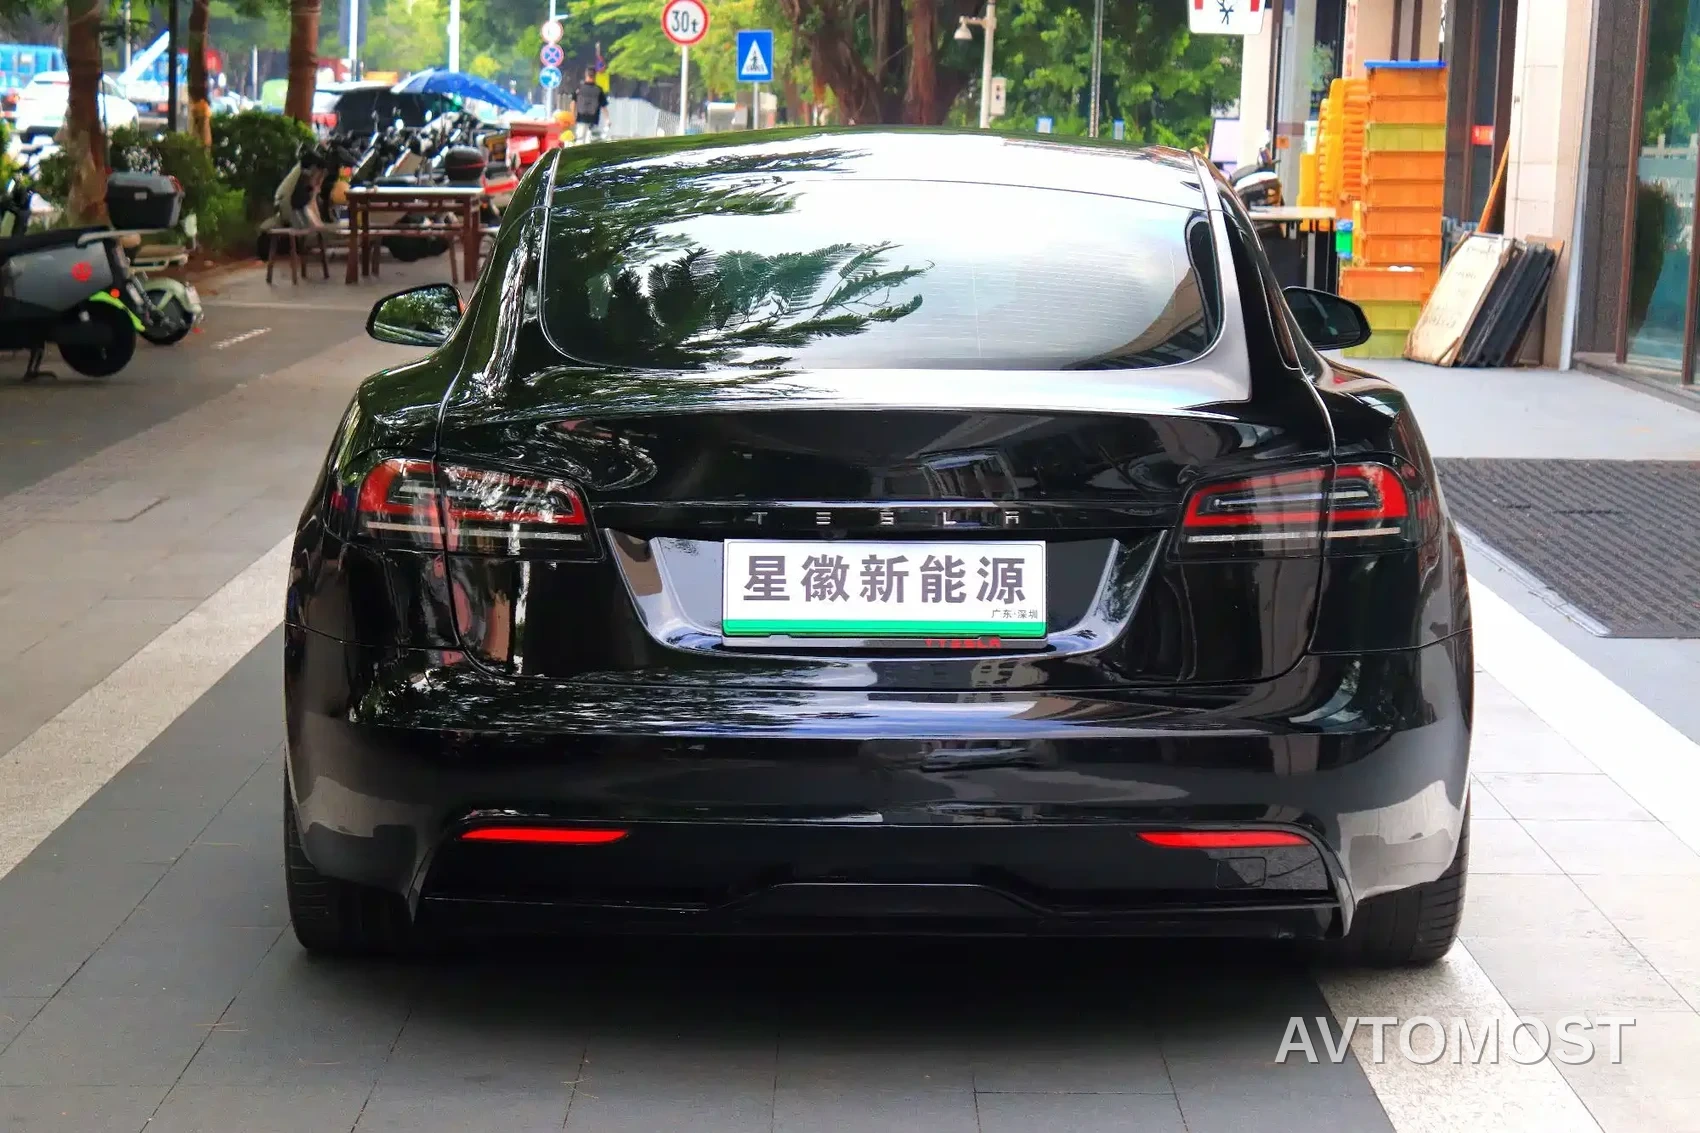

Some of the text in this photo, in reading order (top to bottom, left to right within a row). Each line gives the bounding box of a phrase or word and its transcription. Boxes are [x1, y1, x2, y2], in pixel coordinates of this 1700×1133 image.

[753, 511, 1020, 527] TESLA
[743, 554, 1026, 605] 星徽新能源
